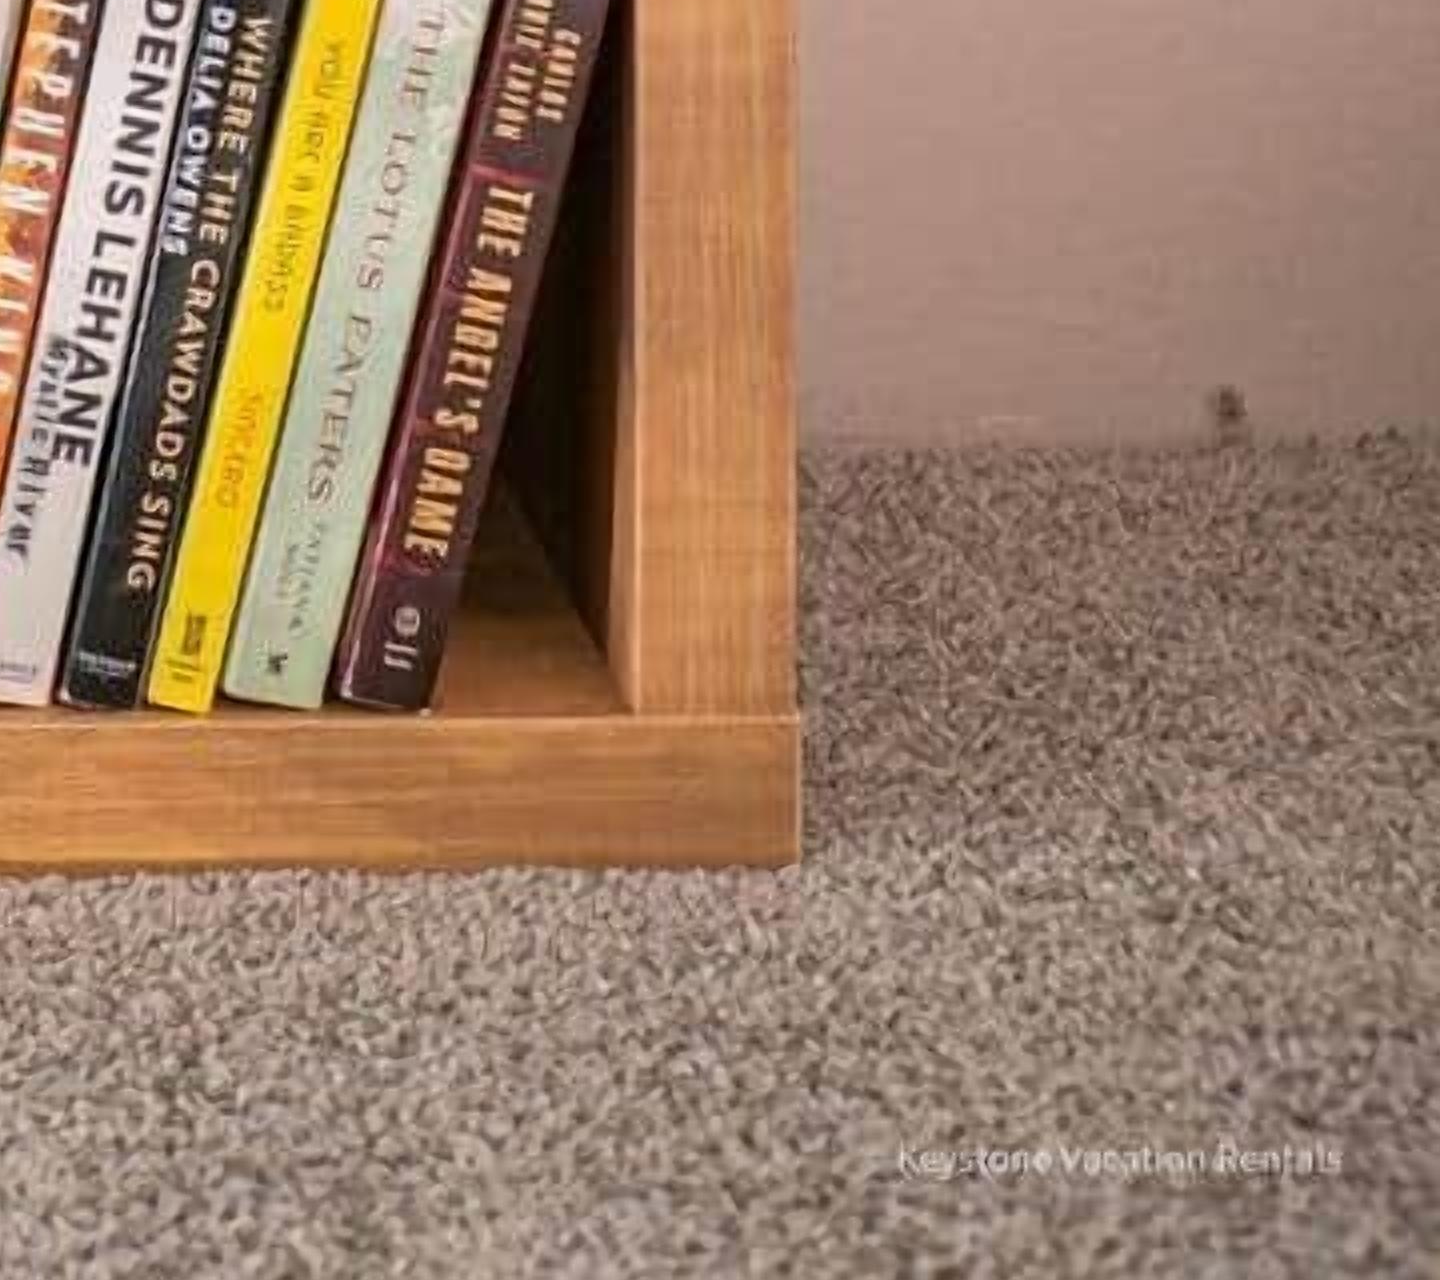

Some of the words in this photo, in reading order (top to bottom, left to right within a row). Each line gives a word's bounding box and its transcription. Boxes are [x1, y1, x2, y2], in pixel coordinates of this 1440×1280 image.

[188, 5, 238, 111] DELIA
[215, 16, 273, 154] WHERE
[398, 7, 448, 112] THE
[157, 124, 214, 256] OWENS
[195, 167, 241, 245] THE
[355, 132, 418, 291] LOTUS
[473, 182, 534, 257] THE
[48, 230, 137, 466] LEHANE
[146, 259, 222, 481] CRAWDADS
[431, 266, 515, 435] ANGEL'S
[123, 490, 172, 590] SING
[401, 446, 471, 559] GAME
